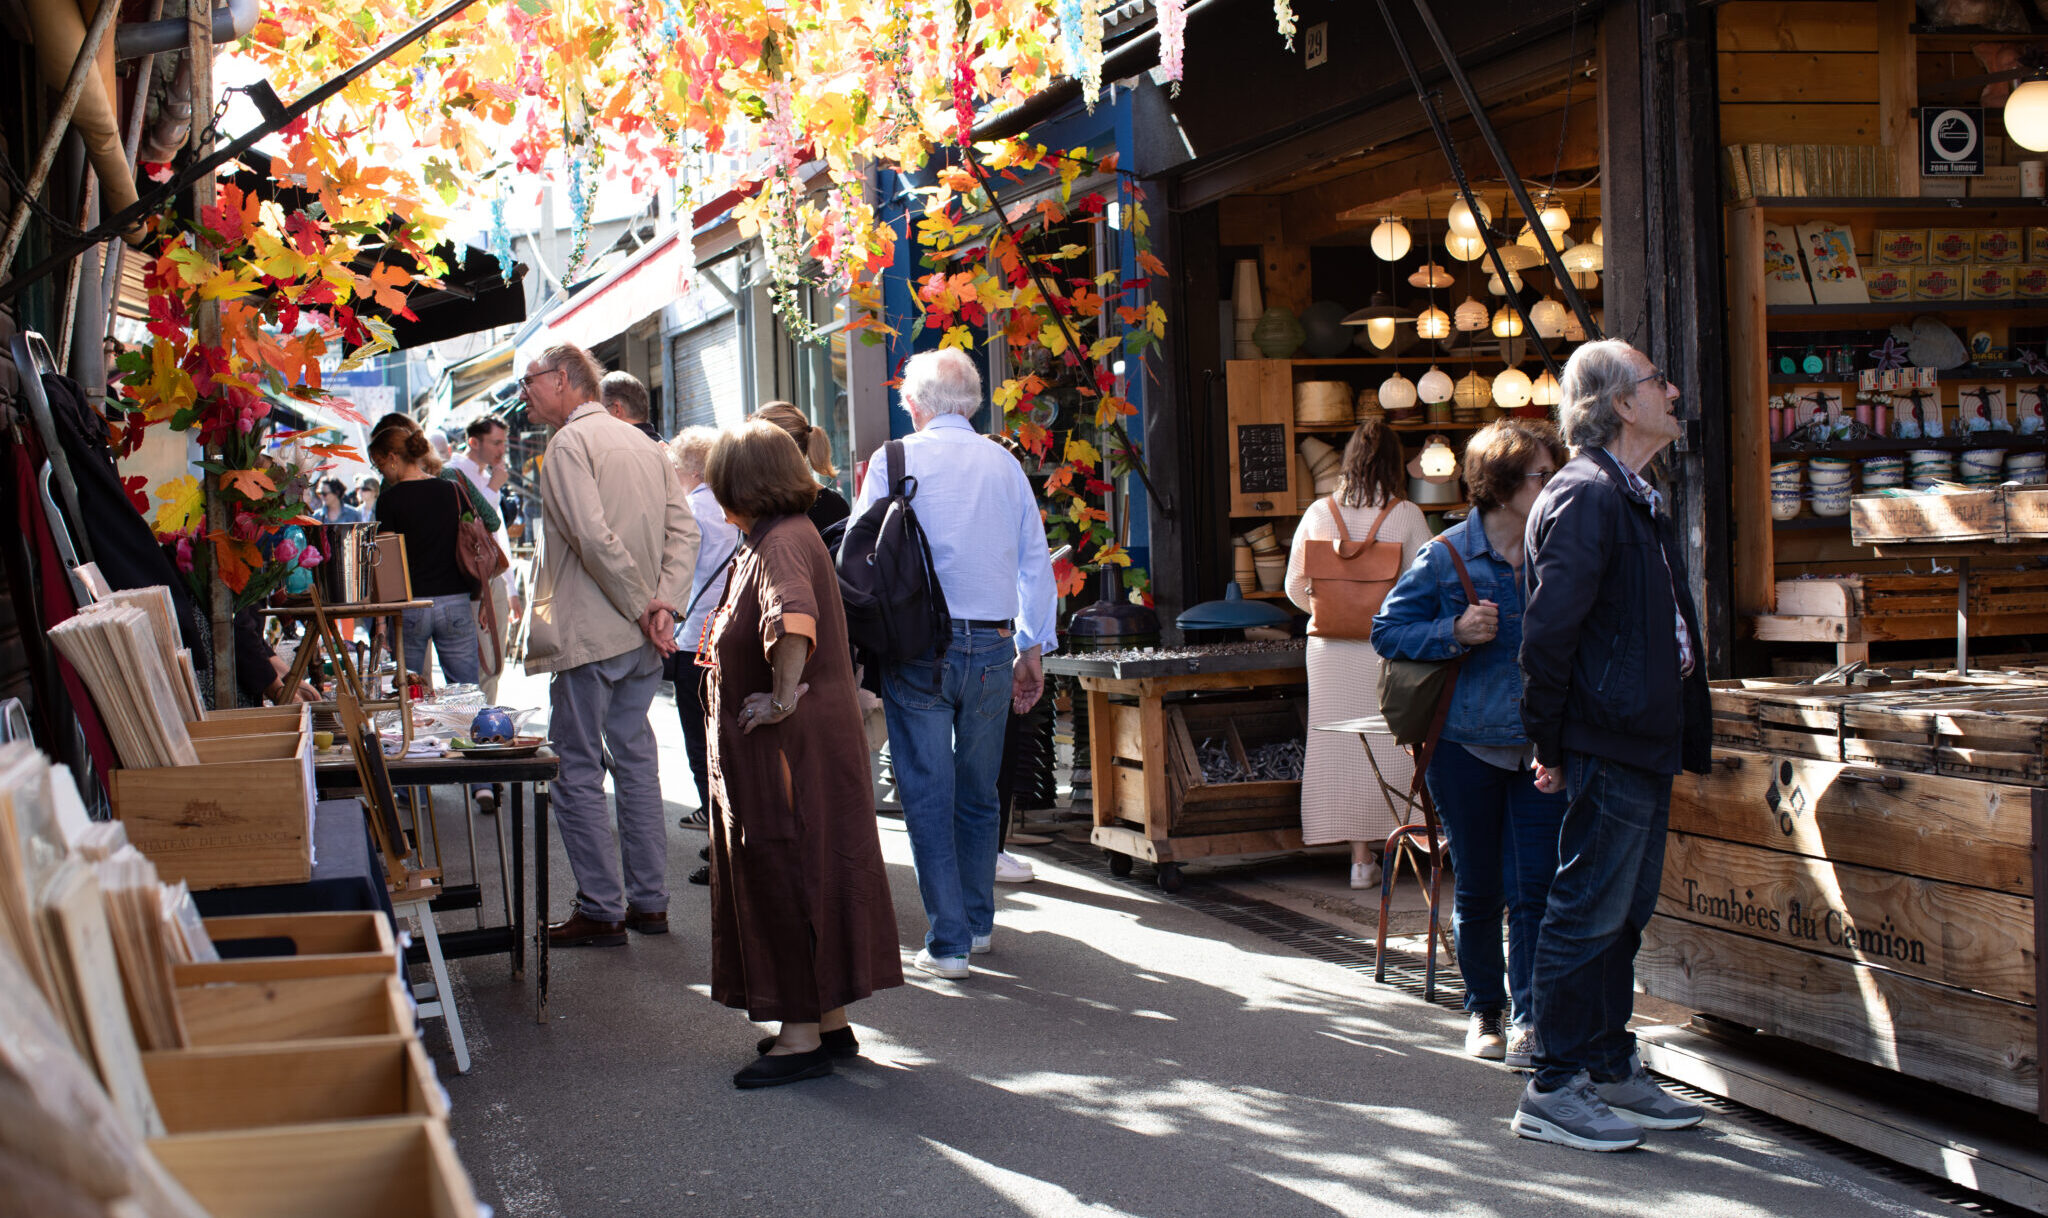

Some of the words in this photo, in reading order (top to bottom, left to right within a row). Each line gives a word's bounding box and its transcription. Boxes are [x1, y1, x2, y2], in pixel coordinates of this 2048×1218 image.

[1307, 30, 1322, 60] 29
[1951, 161, 1977, 171] fumeur
[200, 836, 217, 847] DE
[222, 831, 290, 846] PLAISANCE
[1788, 897, 1818, 941] du
